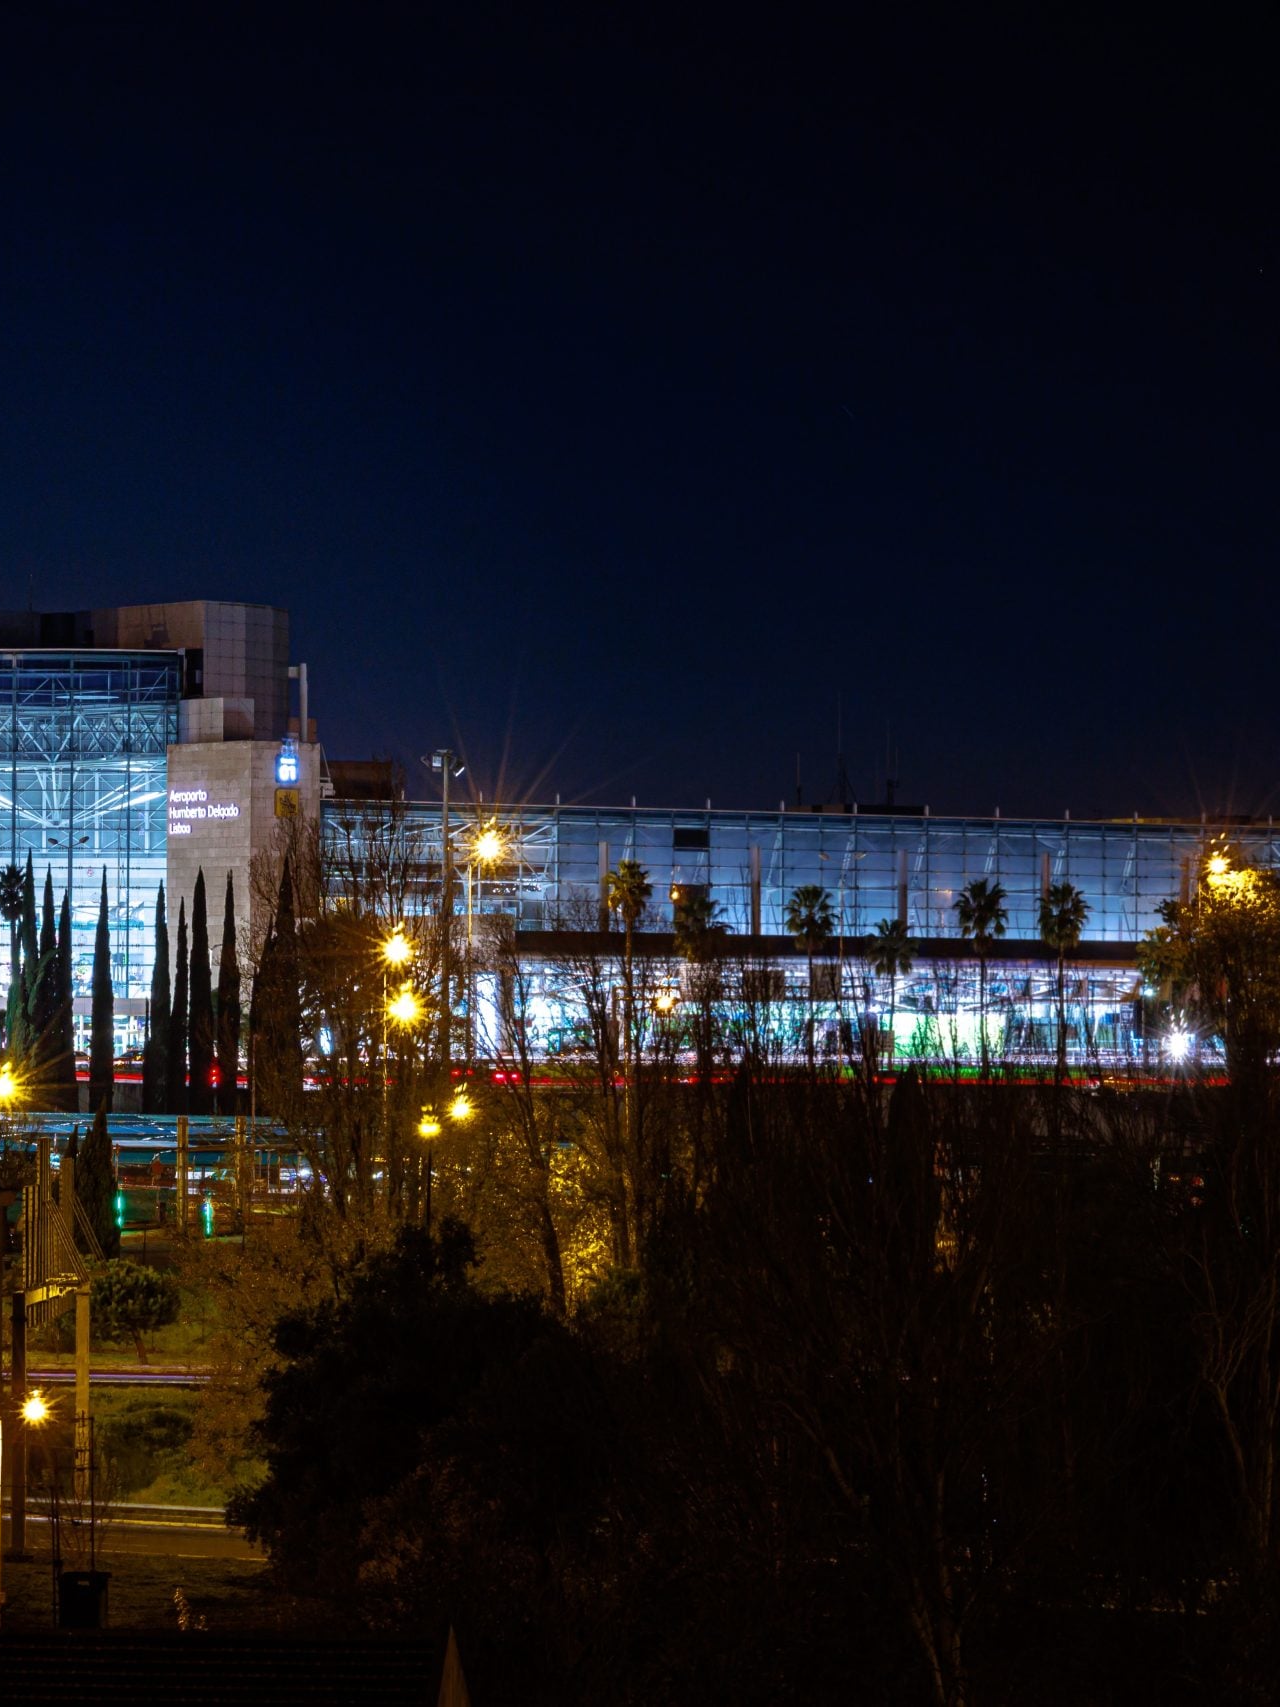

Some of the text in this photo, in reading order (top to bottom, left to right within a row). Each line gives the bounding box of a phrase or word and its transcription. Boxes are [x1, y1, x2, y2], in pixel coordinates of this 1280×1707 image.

[169, 790, 207, 804] Aeroporto
[169, 804, 239, 819] Humberto Delgado
[169, 823, 191, 834] Lisboa
